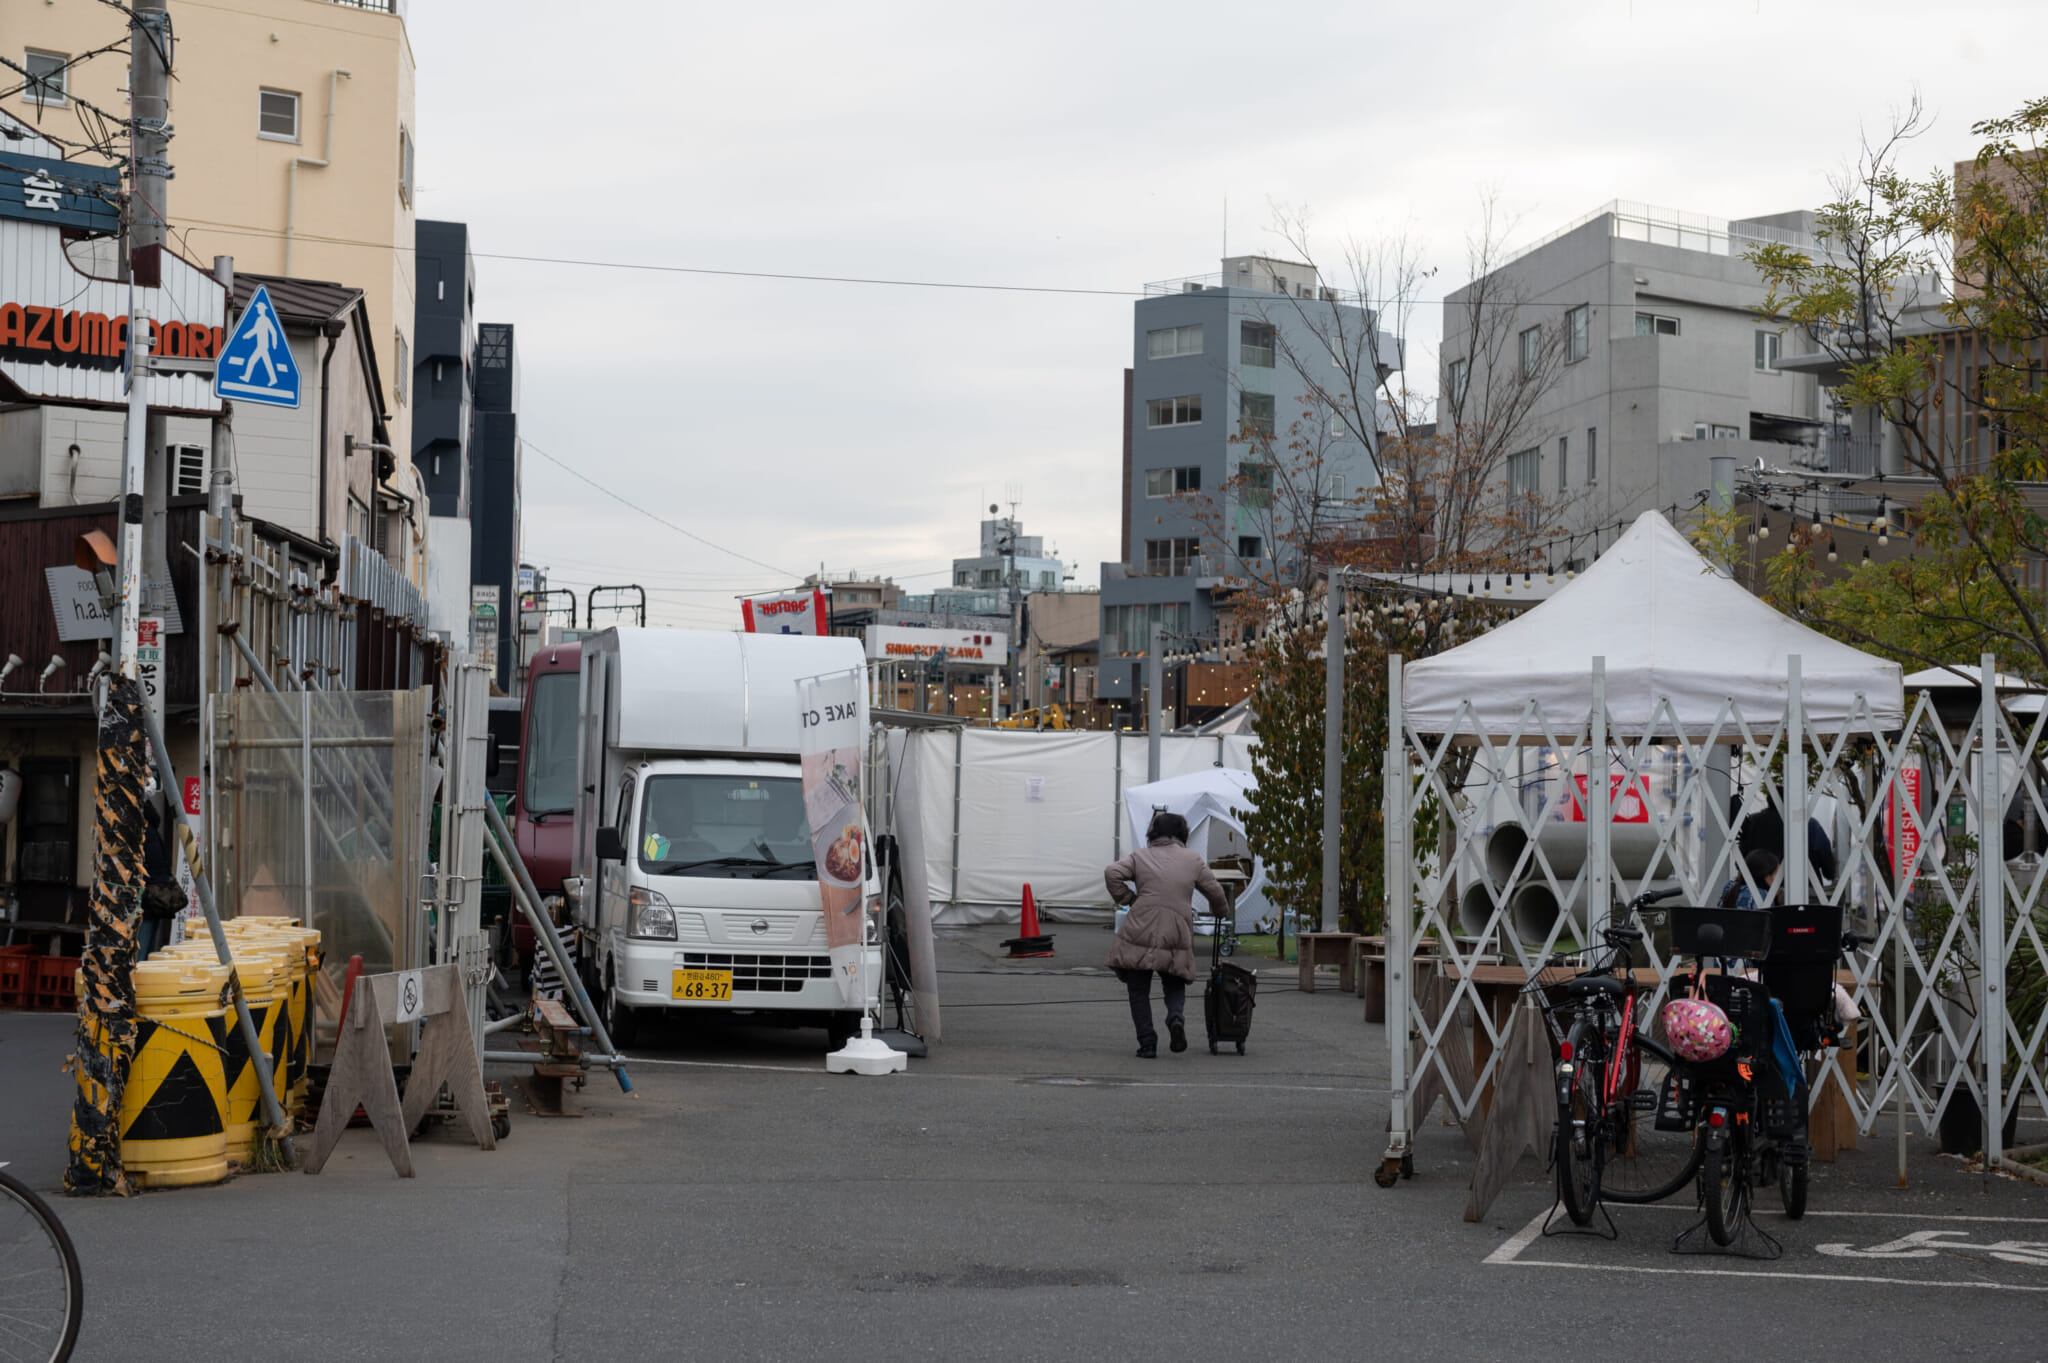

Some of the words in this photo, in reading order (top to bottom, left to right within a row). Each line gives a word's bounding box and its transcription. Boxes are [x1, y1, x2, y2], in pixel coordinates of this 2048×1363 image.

[22, 168, 64, 212] 会
[885, 643, 984, 659] SHIMOKITZAWA
[686, 982, 729, 998] 68-37
